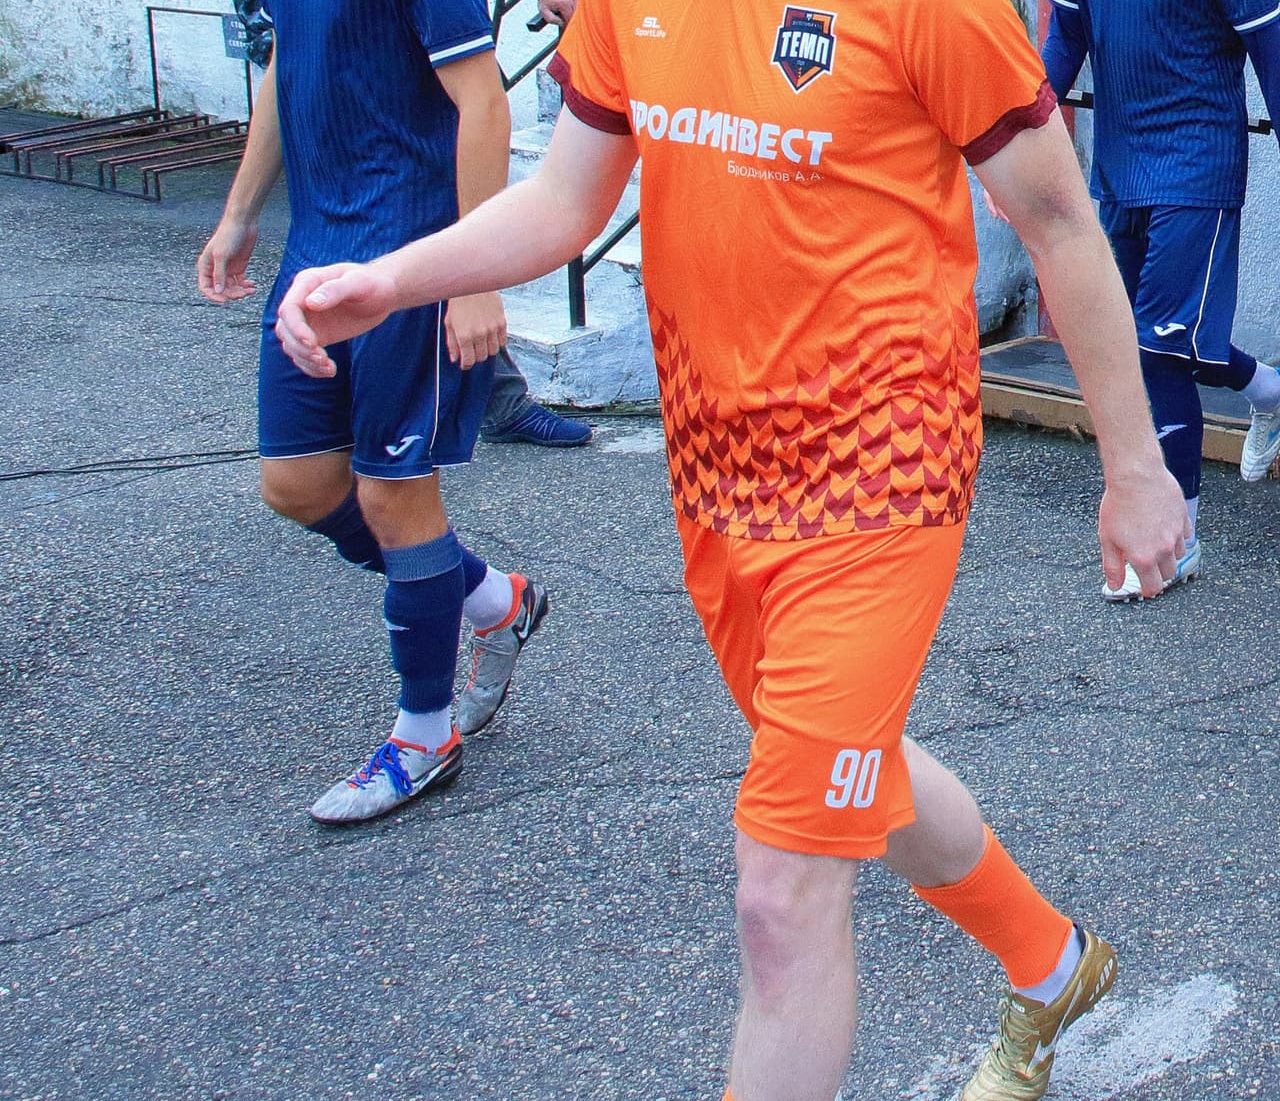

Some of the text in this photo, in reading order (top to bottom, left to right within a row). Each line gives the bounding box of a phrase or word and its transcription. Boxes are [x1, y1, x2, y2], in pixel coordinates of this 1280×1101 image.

[780, 31, 830, 65] ТЕМП
[727, 160, 790, 182] Бродников
[824, 748, 882, 809] 90
